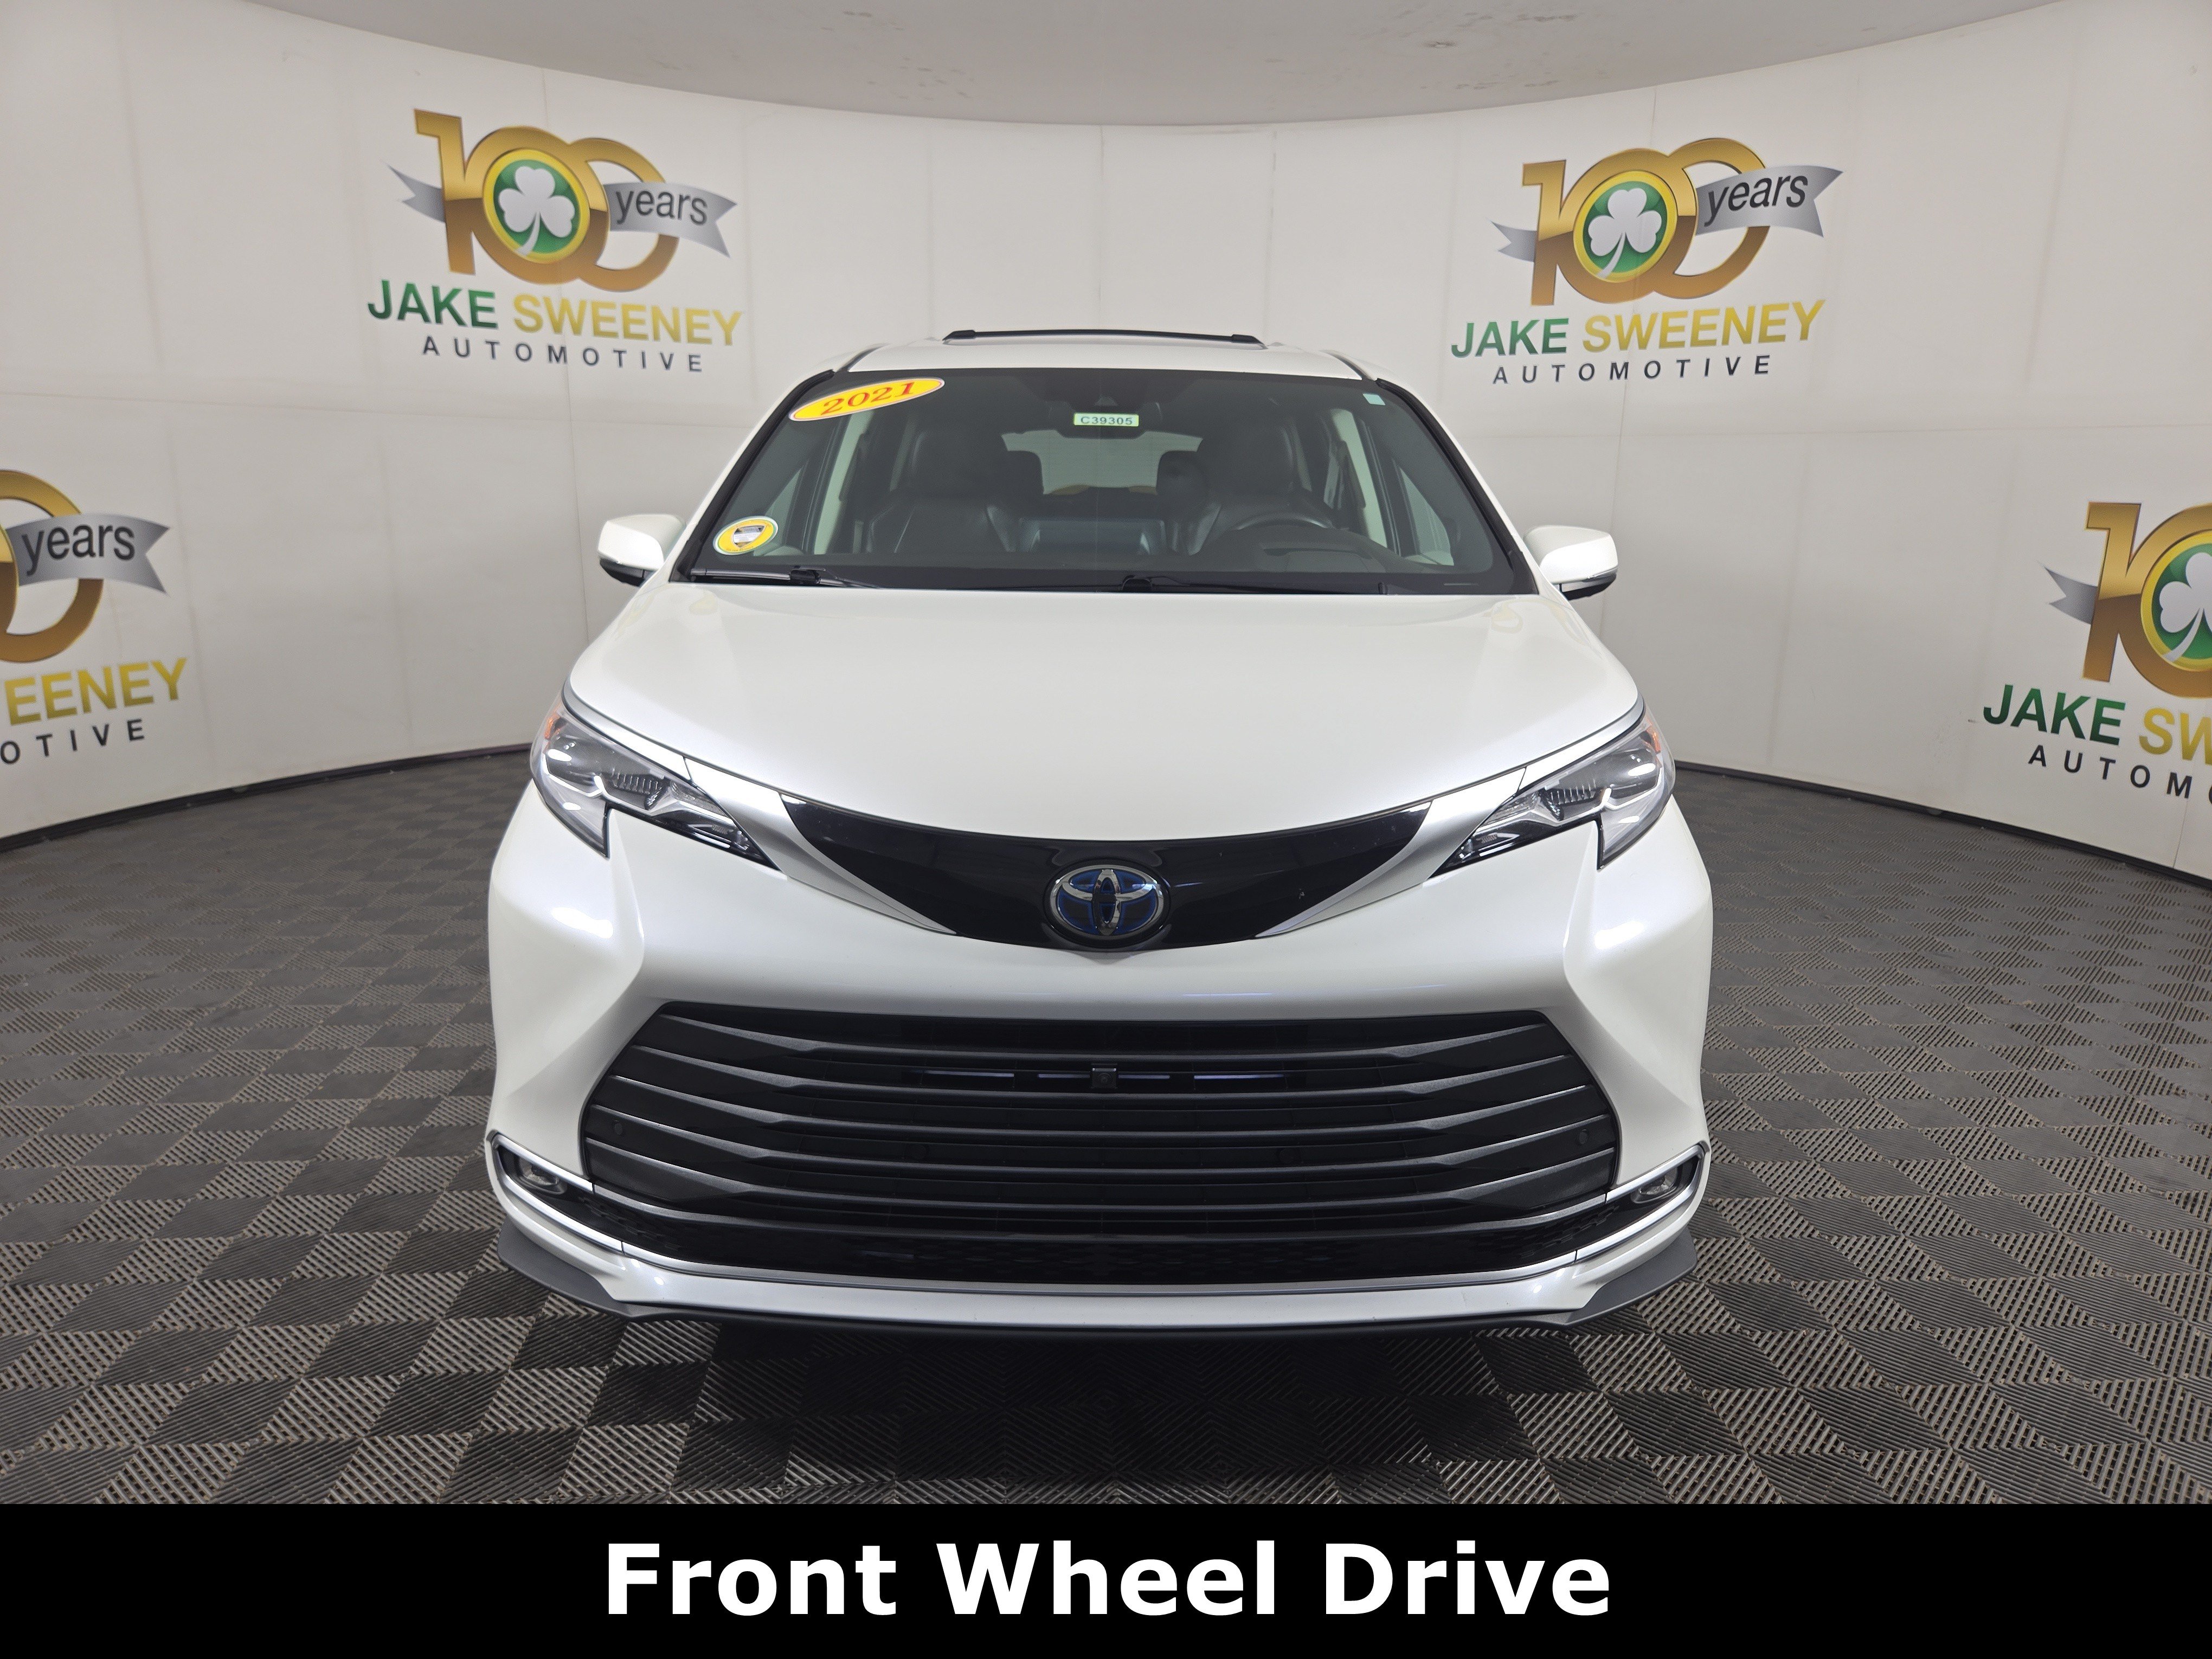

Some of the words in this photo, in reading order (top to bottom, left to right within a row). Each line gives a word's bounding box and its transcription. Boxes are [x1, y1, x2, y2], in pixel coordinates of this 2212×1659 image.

[615, 187, 708, 226] years
[1704, 173, 1809, 226] years
[368, 279, 498, 330] JAKE
[513, 293, 743, 346] SWEENEY
[1451, 317, 1569, 359] JAKE
[1582, 299, 1825, 353] SWEENEY
[422, 336, 703, 372] AUTOMOTIVE
[1493, 355, 1771, 384] AUTOMOTIVE
[820, 381, 915, 416] 2021
[1080, 416, 1133, 425] C39305
[21, 523, 136, 576] years
[4, 657, 188, 726] EENEY
[1983, 684, 2126, 746] JAKE
[1, 718, 145, 764] OTIVE
[2028, 744, 2212, 806] AUTOM
